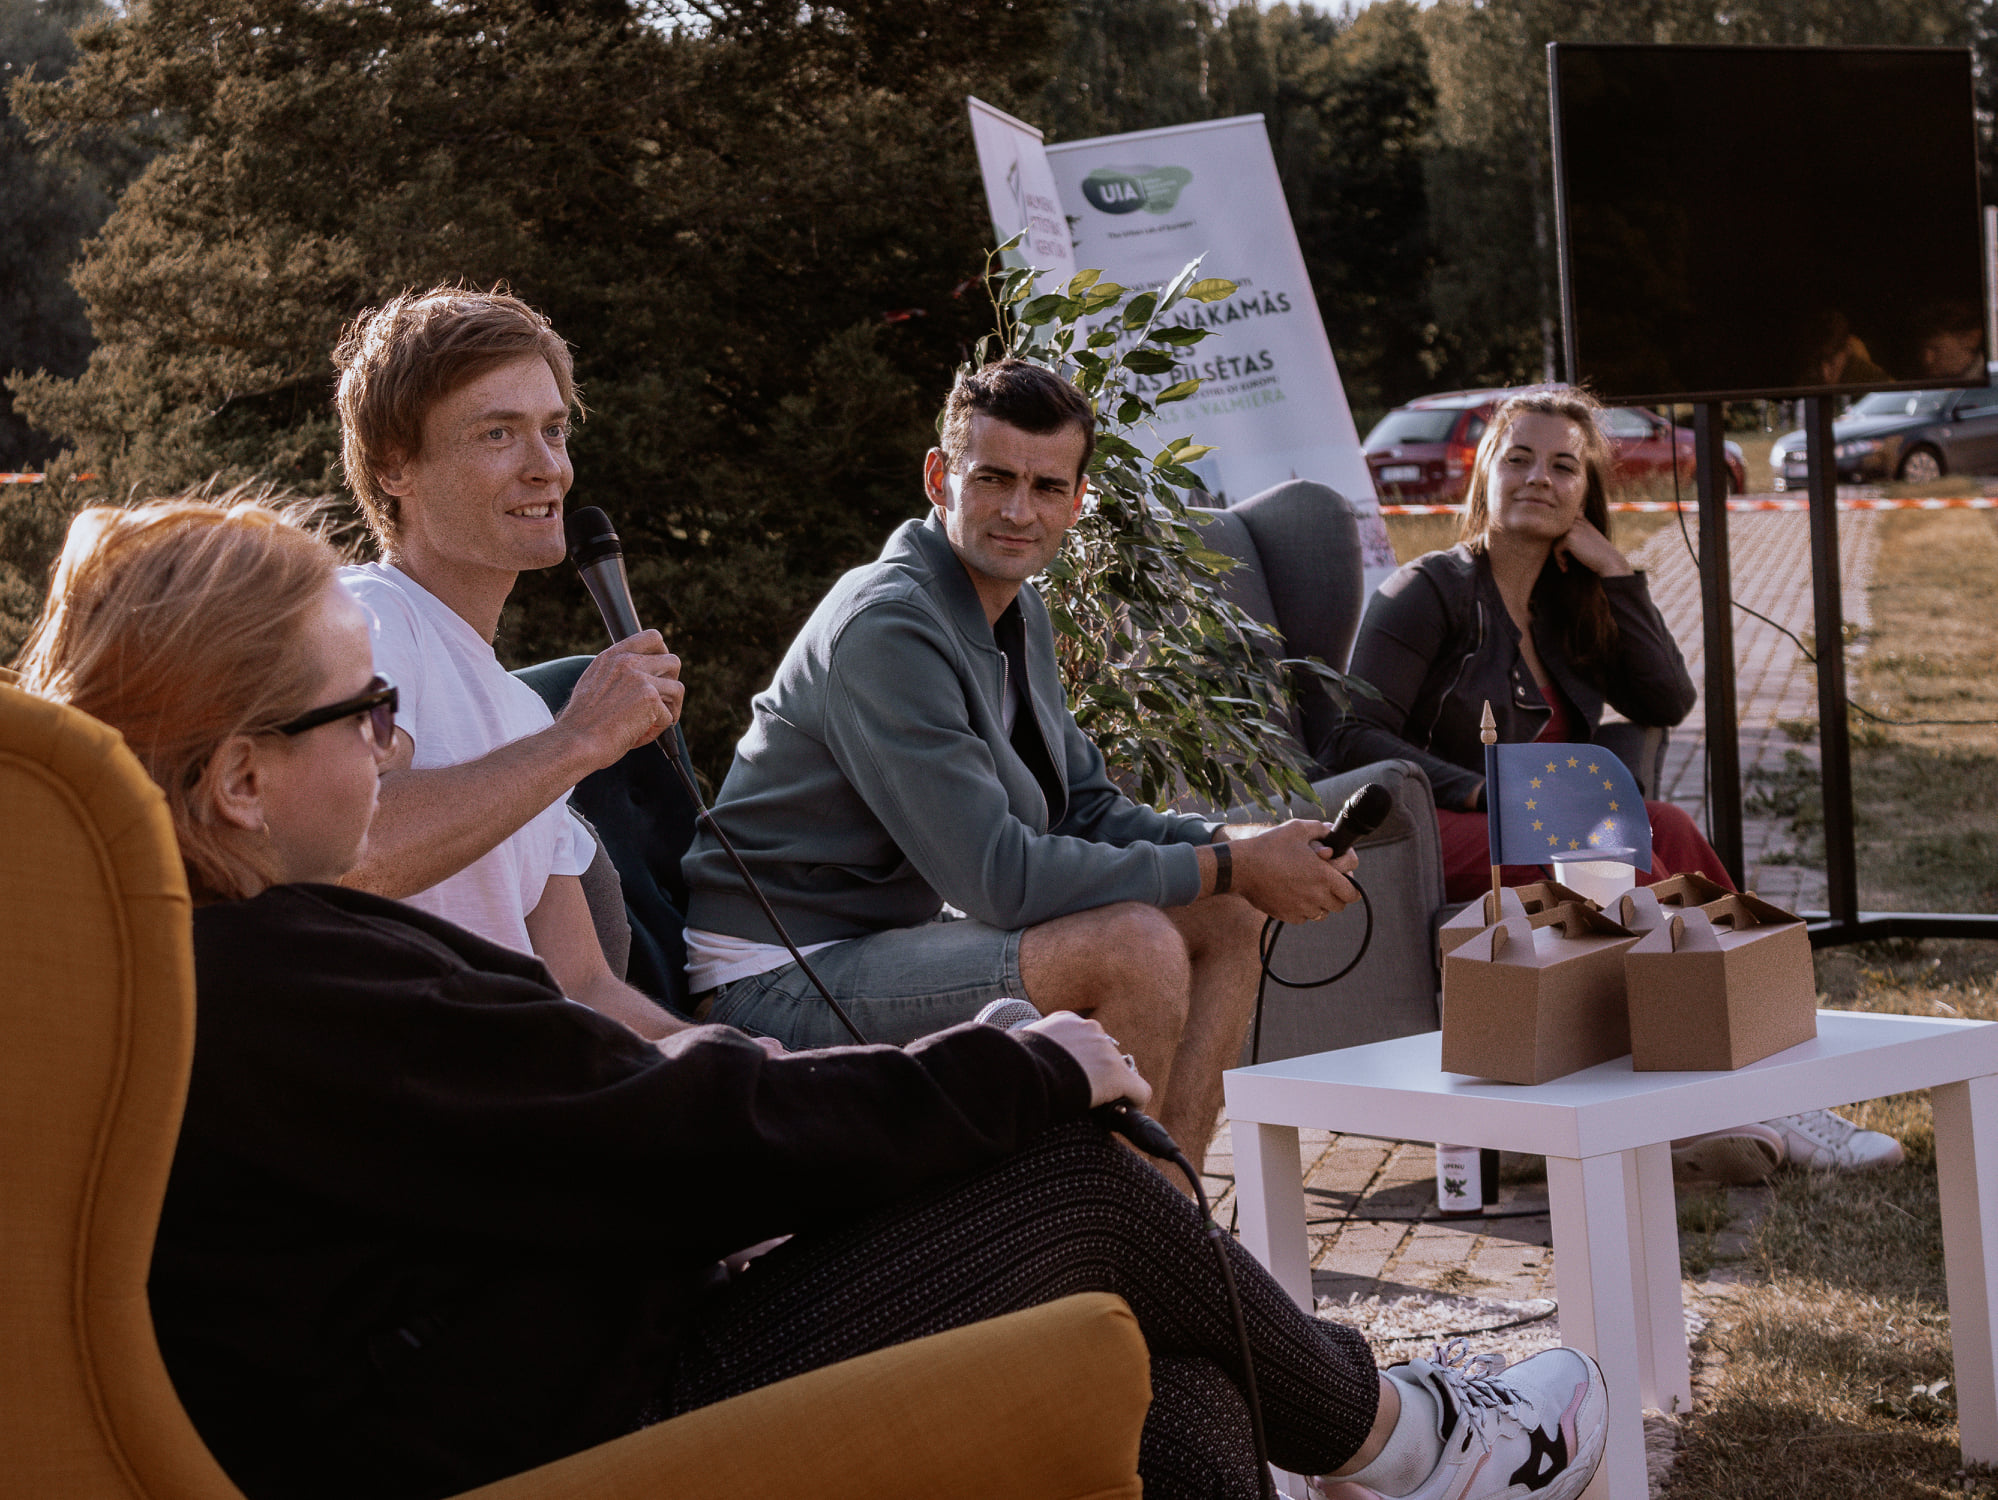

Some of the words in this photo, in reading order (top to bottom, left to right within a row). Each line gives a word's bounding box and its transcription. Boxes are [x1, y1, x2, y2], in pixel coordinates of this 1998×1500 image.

[1100, 181, 1140, 203] UIA
[1173, 290, 1292, 329] NĀKAMĀS
[1241, 375, 1279, 391] EUROPE
[1202, 387, 1287, 416] VALMIERA
